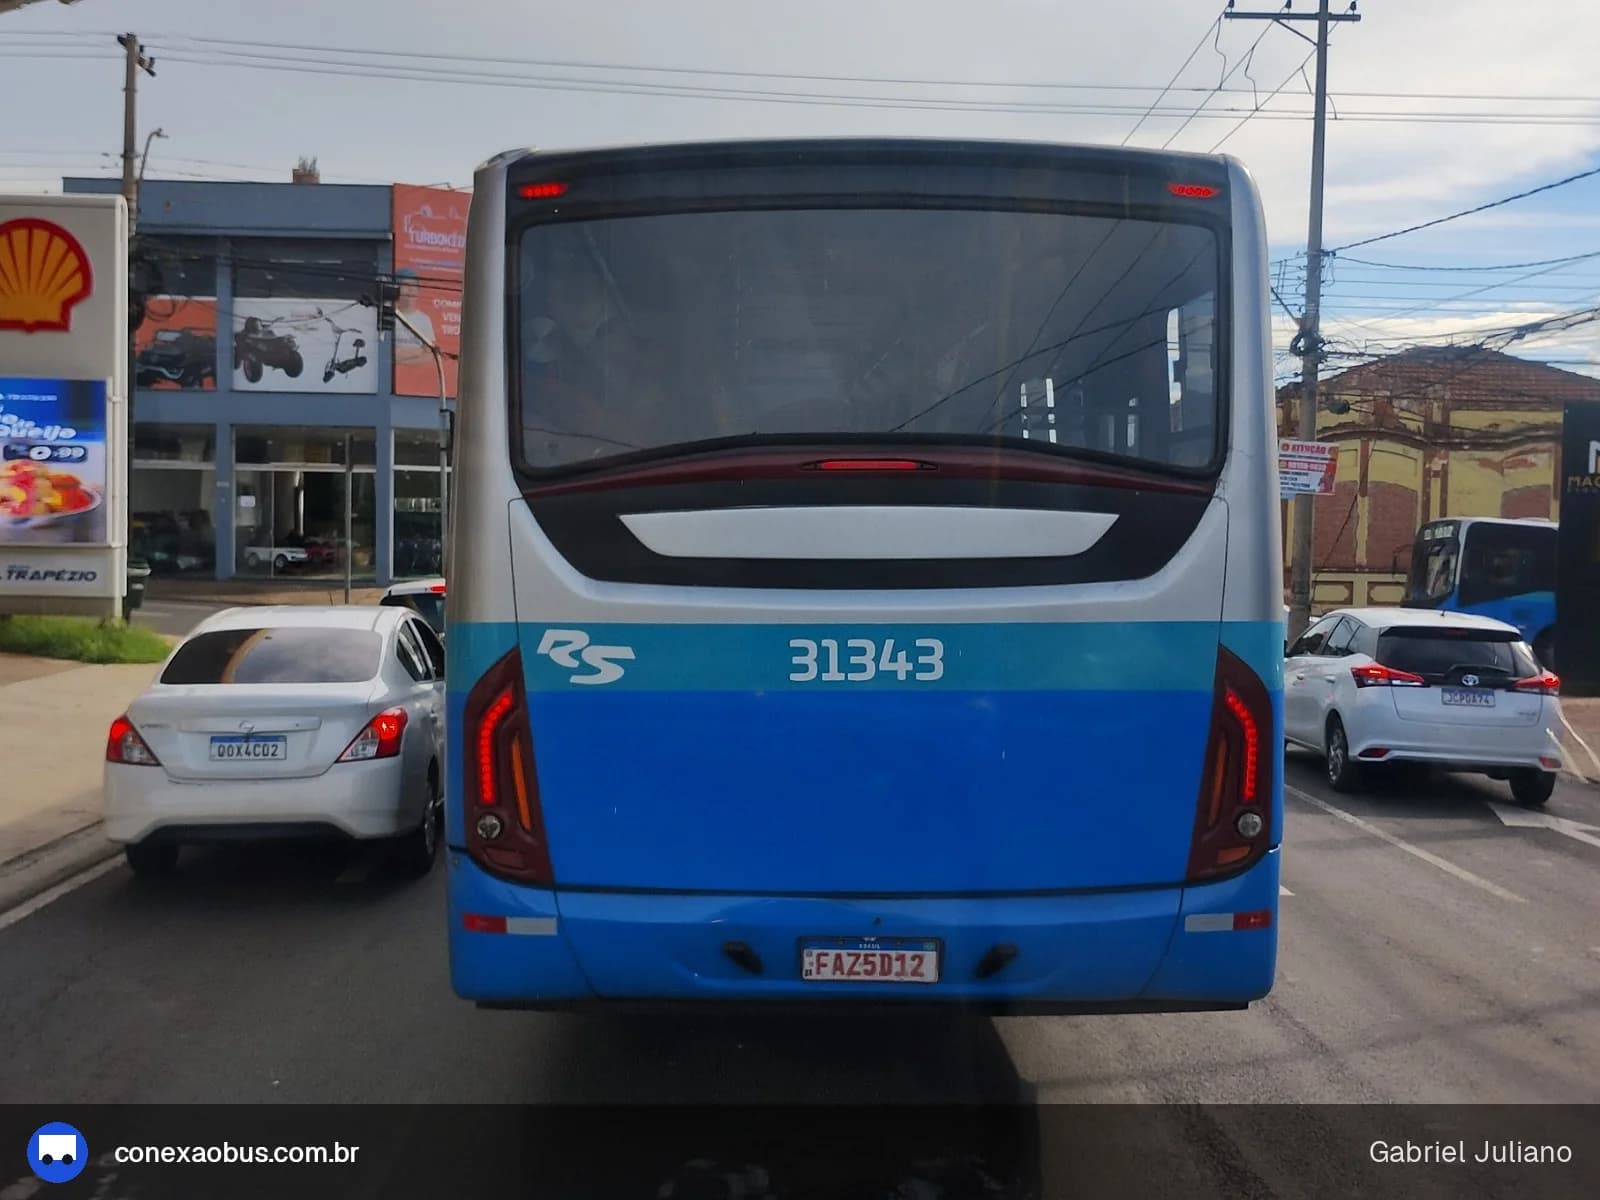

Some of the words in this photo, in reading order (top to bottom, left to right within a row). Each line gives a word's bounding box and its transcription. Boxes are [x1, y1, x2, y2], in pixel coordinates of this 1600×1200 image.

[7, 569, 97, 582] TRAPÉZIO
[536, 629, 636, 685] RS
[789, 638, 944, 682] 31343
[816, 952, 925, 978] FAZ5D12
